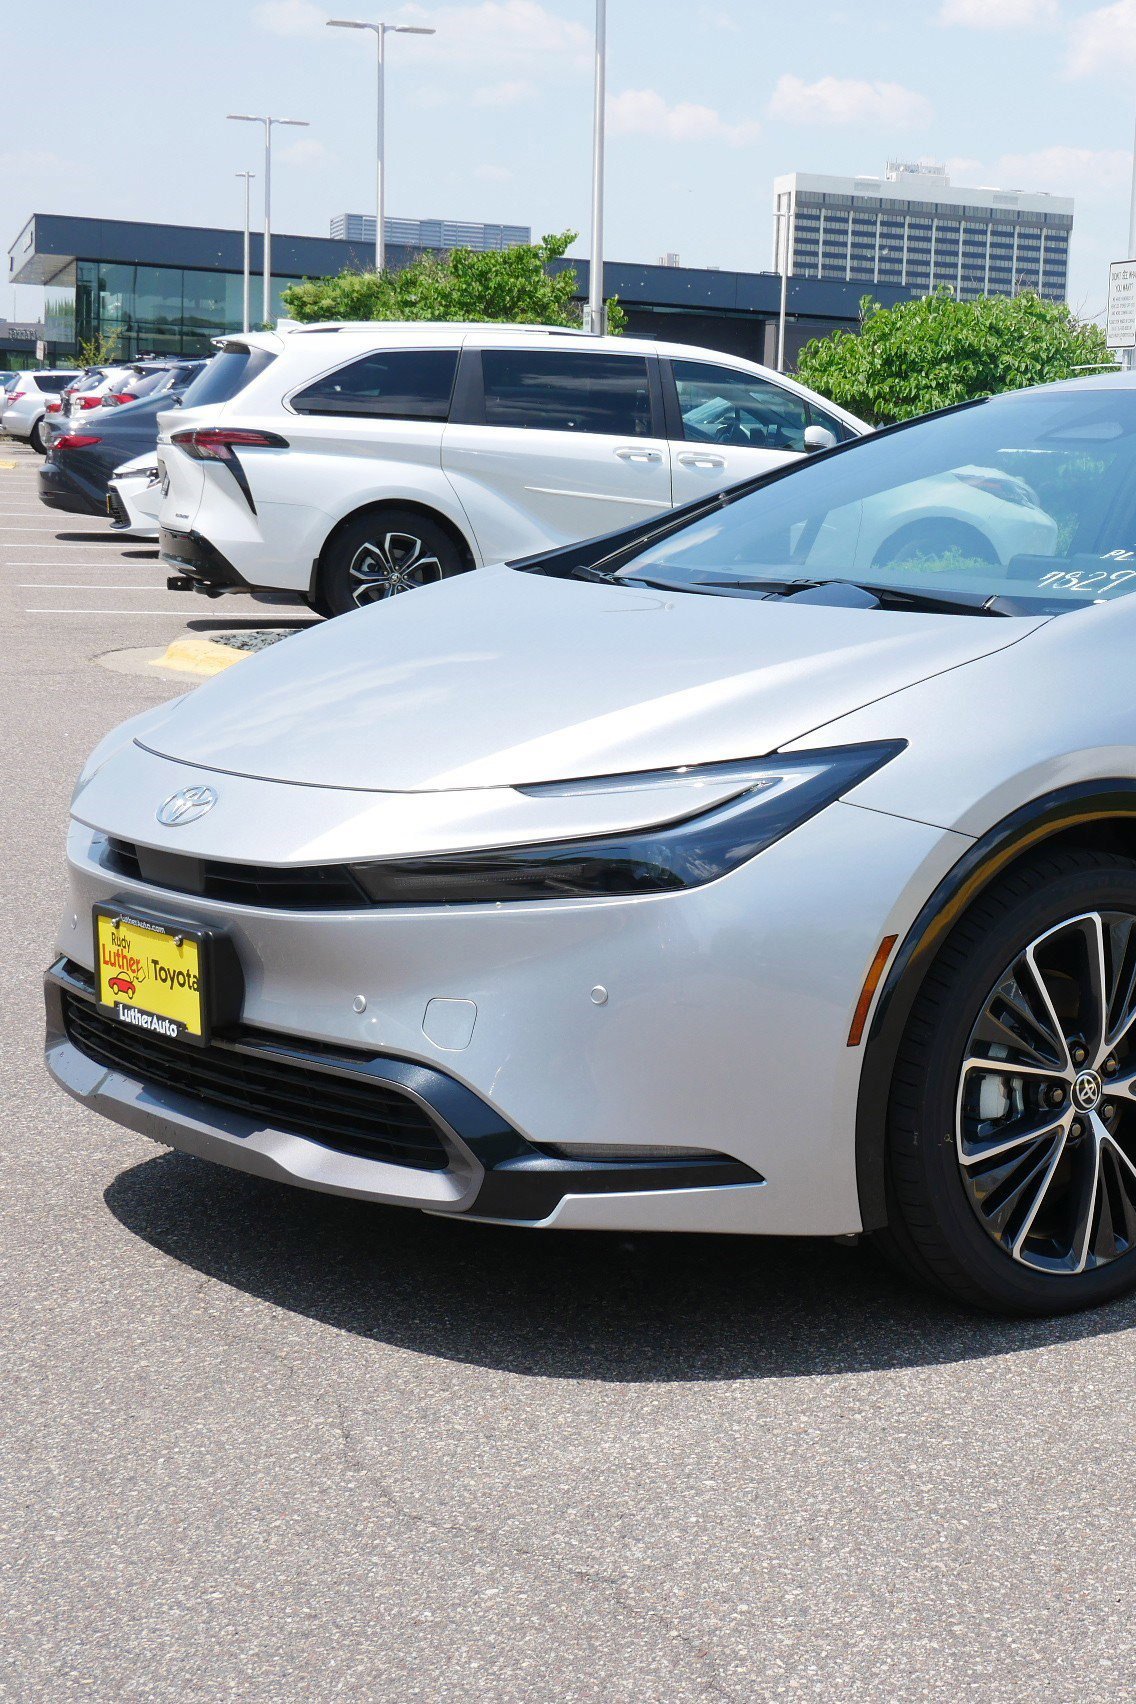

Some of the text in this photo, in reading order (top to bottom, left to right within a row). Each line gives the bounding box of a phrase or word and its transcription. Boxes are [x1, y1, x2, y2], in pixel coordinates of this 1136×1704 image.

[102, 943, 141, 974] Luther
[111, 932, 131, 953] Rudy
[151, 959, 200, 993] Toyota
[119, 1004, 178, 1038] LutherAuto
